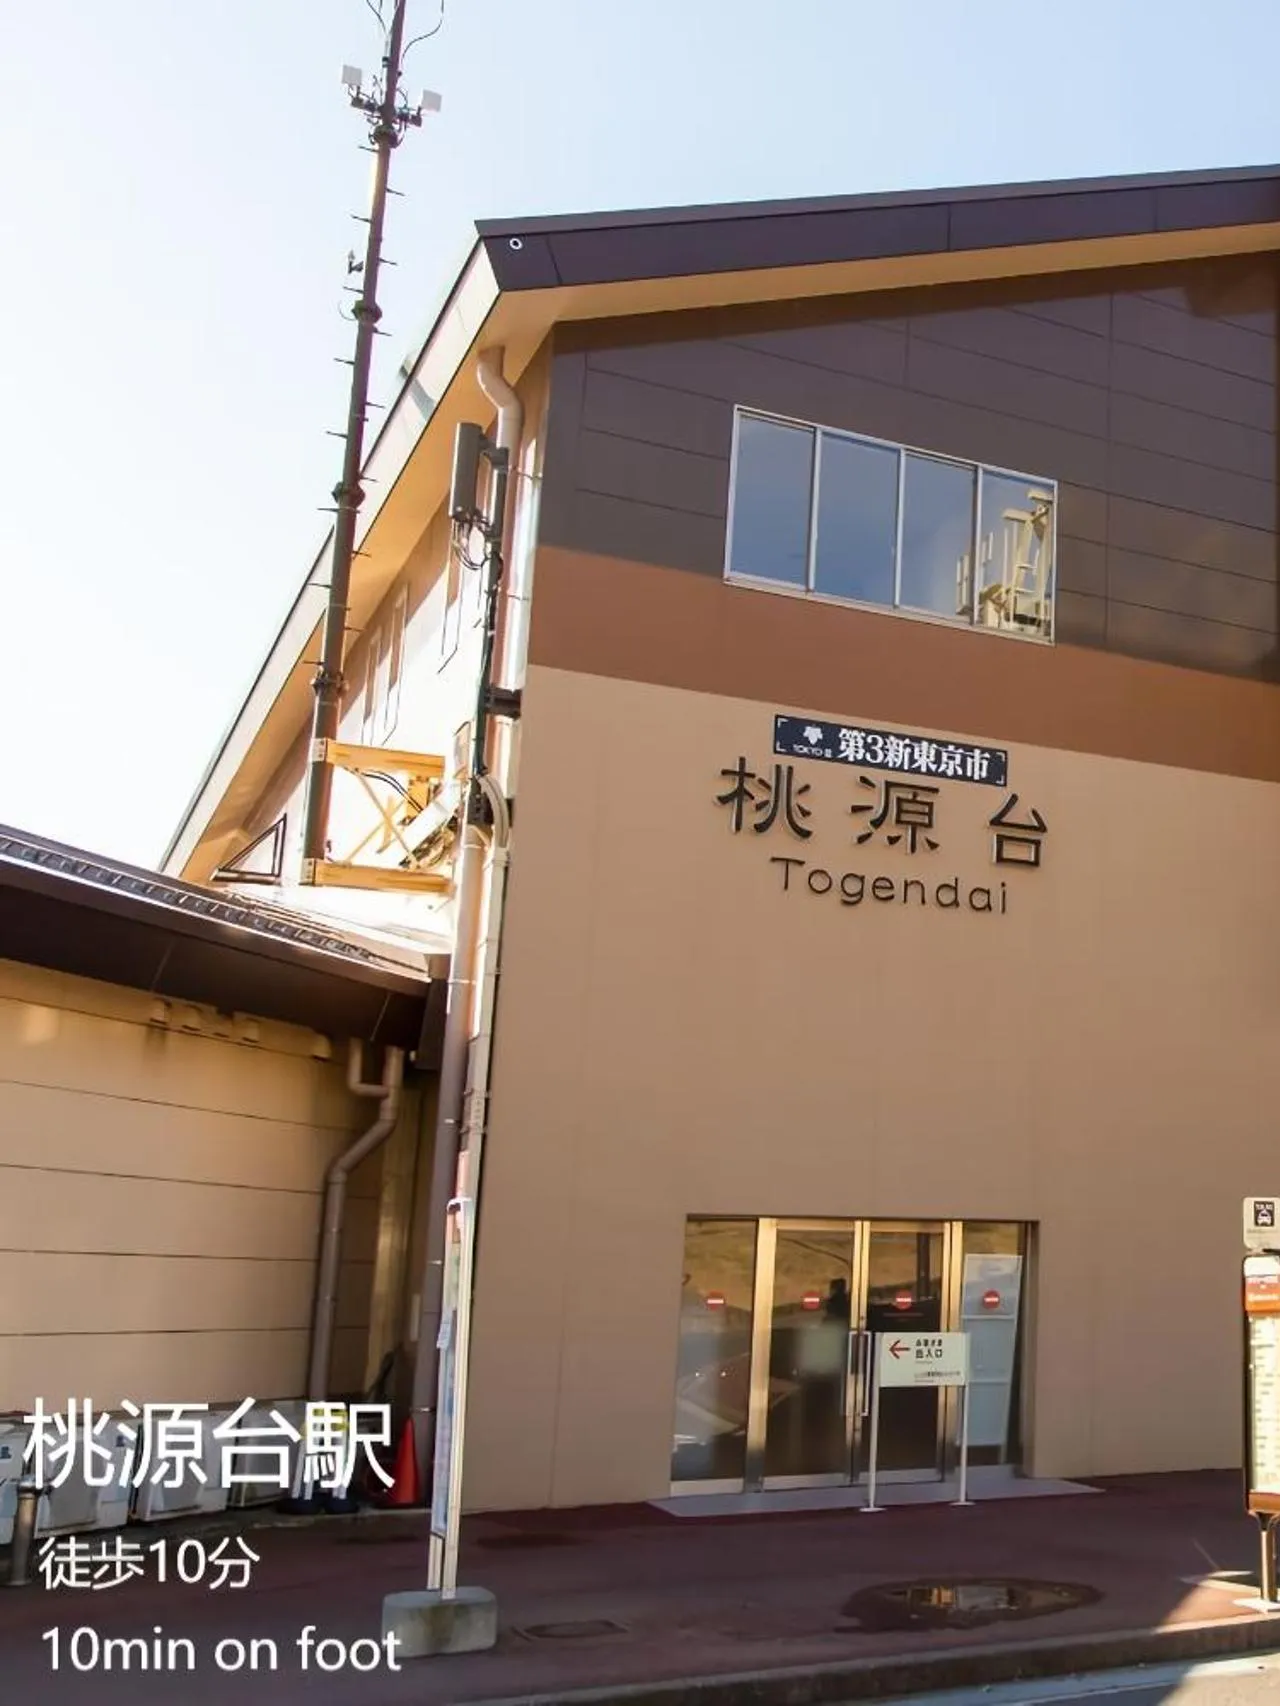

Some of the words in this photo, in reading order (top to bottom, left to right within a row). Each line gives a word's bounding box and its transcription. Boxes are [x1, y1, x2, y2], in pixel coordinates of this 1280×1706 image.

[838, 728, 990, 780] 第3新東京市
[716, 756, 1048, 868] 桃源台
[770, 856, 1008, 913] Togendai
